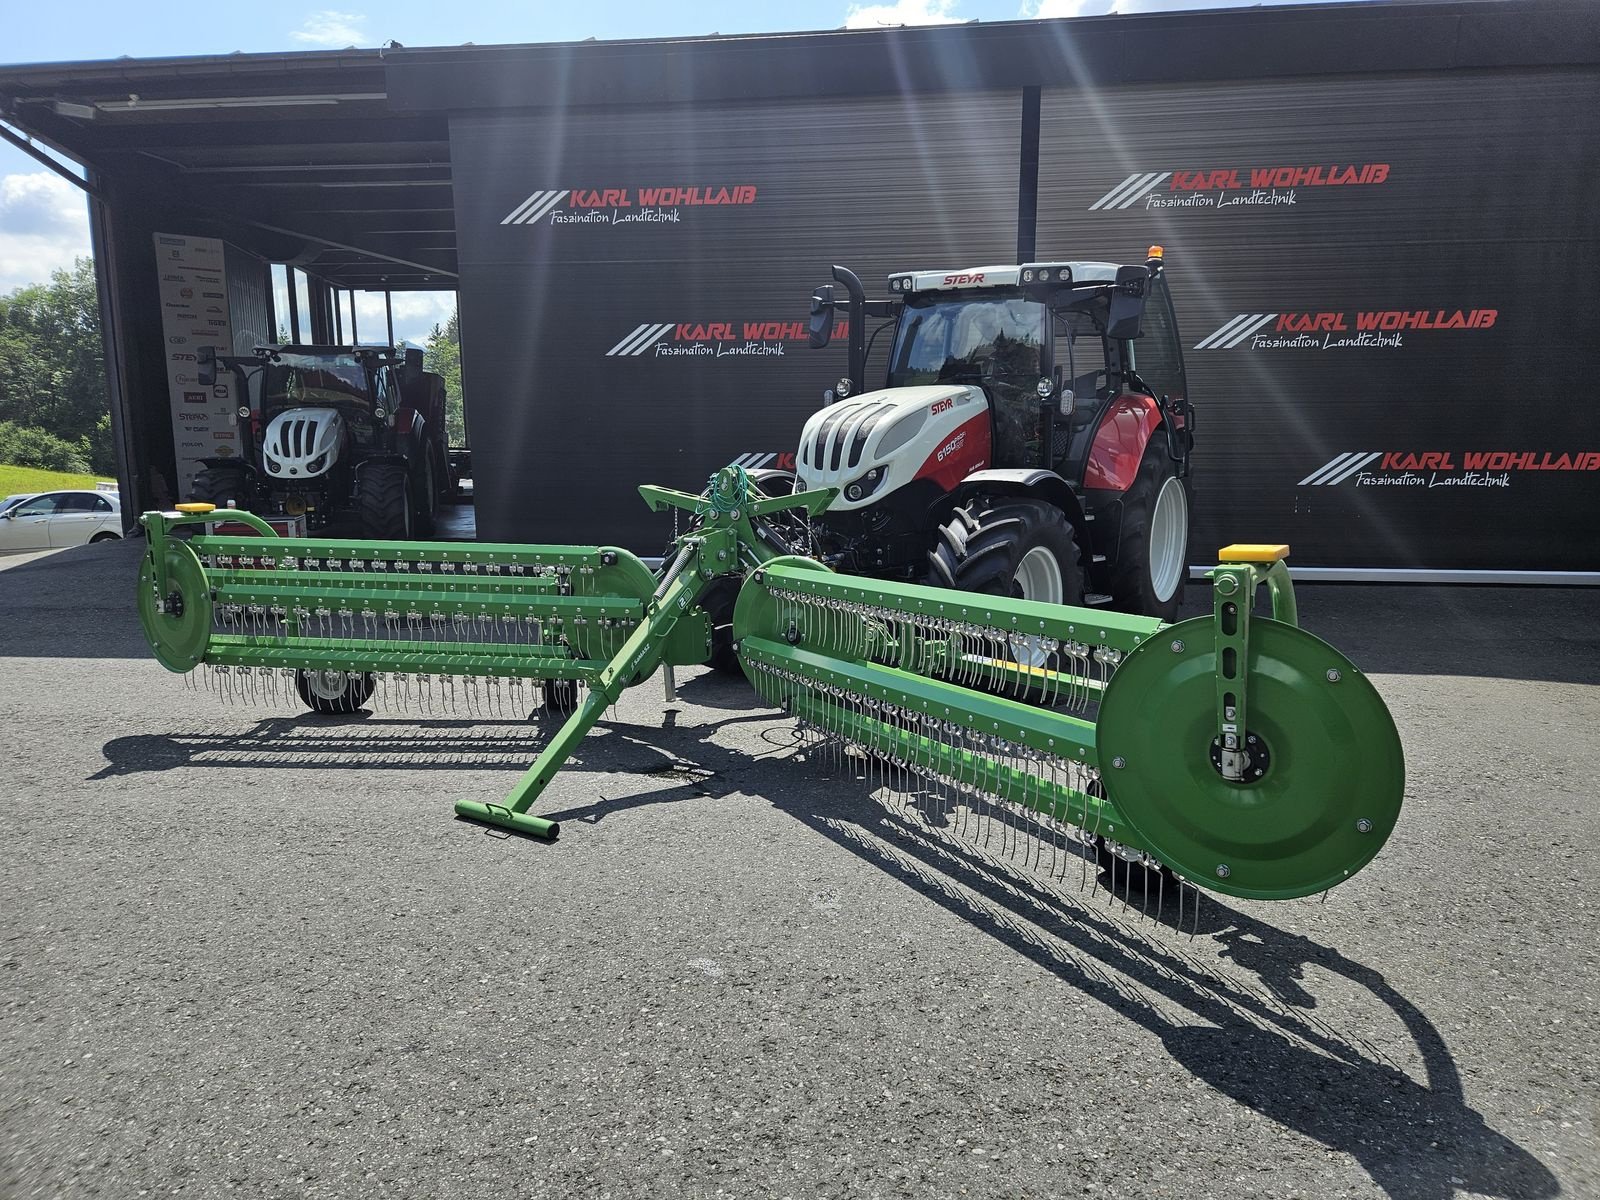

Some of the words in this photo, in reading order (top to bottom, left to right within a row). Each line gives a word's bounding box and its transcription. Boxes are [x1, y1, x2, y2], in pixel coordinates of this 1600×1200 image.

[1170, 170, 1241, 191] KARL
[570, 190, 631, 207] KARL
[1145, 192, 1214, 210] Faszination
[1217, 188, 1297, 209] Landtechnik
[549, 210, 609, 226] Faszination
[612, 208, 680, 225] Landtechnik
[943, 273, 985, 285] STEYR
[675, 323, 736, 340] KARL
[1276, 312, 1346, 332] KARL
[654, 342, 713, 358] Faszination
[717, 341, 785, 358] Landtechnik
[1251, 332, 1319, 351] Faszination
[1323, 331, 1403, 350] Landtechnik
[932, 398, 953, 415] STEYR
[937, 440, 956, 462] 6150
[1380, 451, 1454, 471] KARL
[1355, 471, 1425, 489] Faszination
[1429, 470, 1510, 488] Landtechnik
